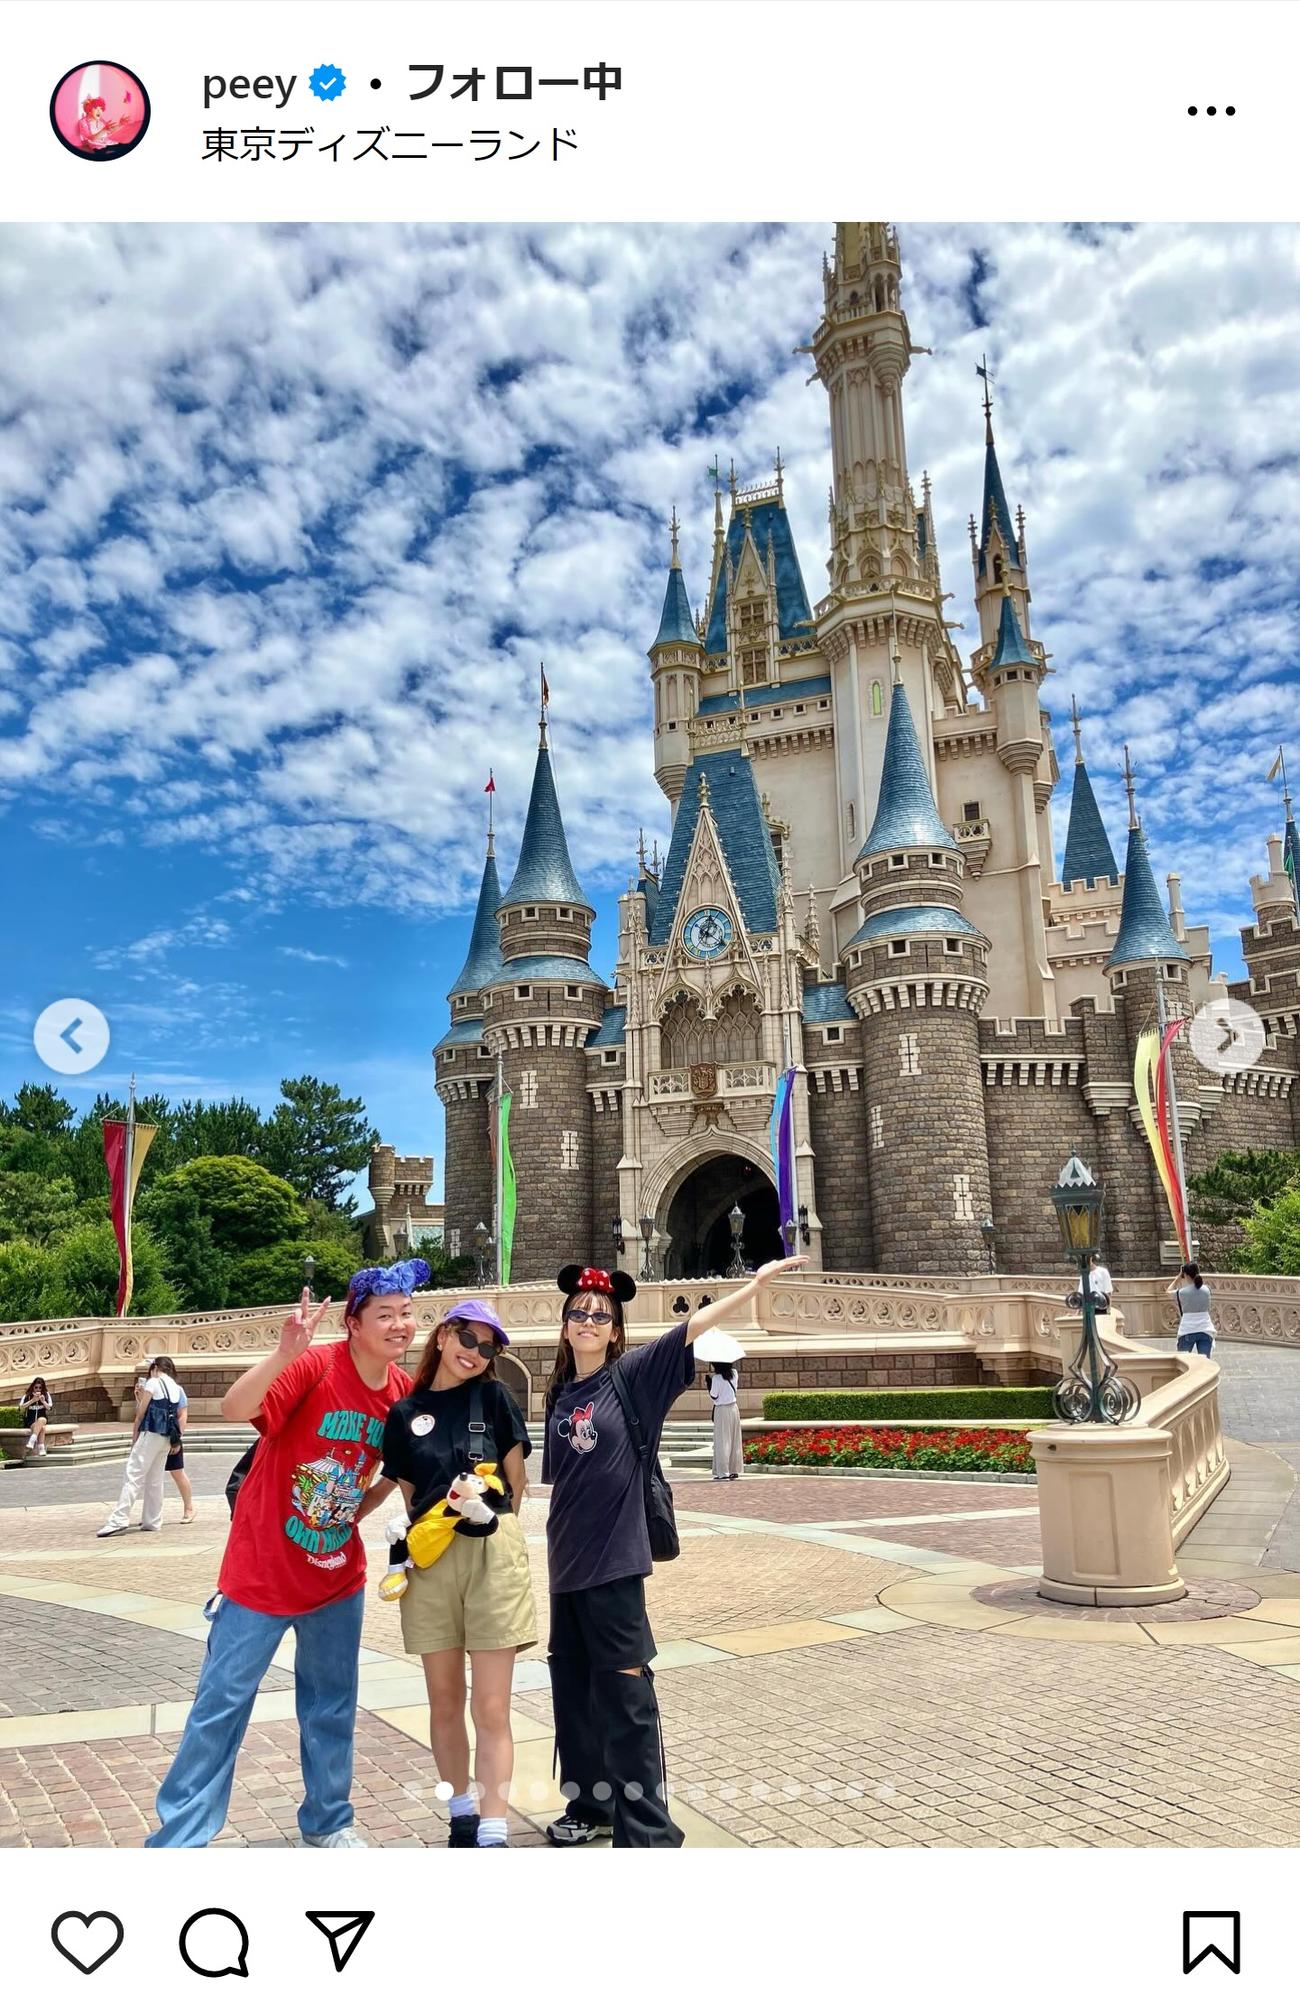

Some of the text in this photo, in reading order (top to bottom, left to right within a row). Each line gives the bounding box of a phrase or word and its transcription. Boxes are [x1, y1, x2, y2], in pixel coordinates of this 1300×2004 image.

[317, 1410, 386, 1448] MAKE YO
[285, 1515, 320, 1554] OWN
[306, 1551, 347, 1570] Disneyland
